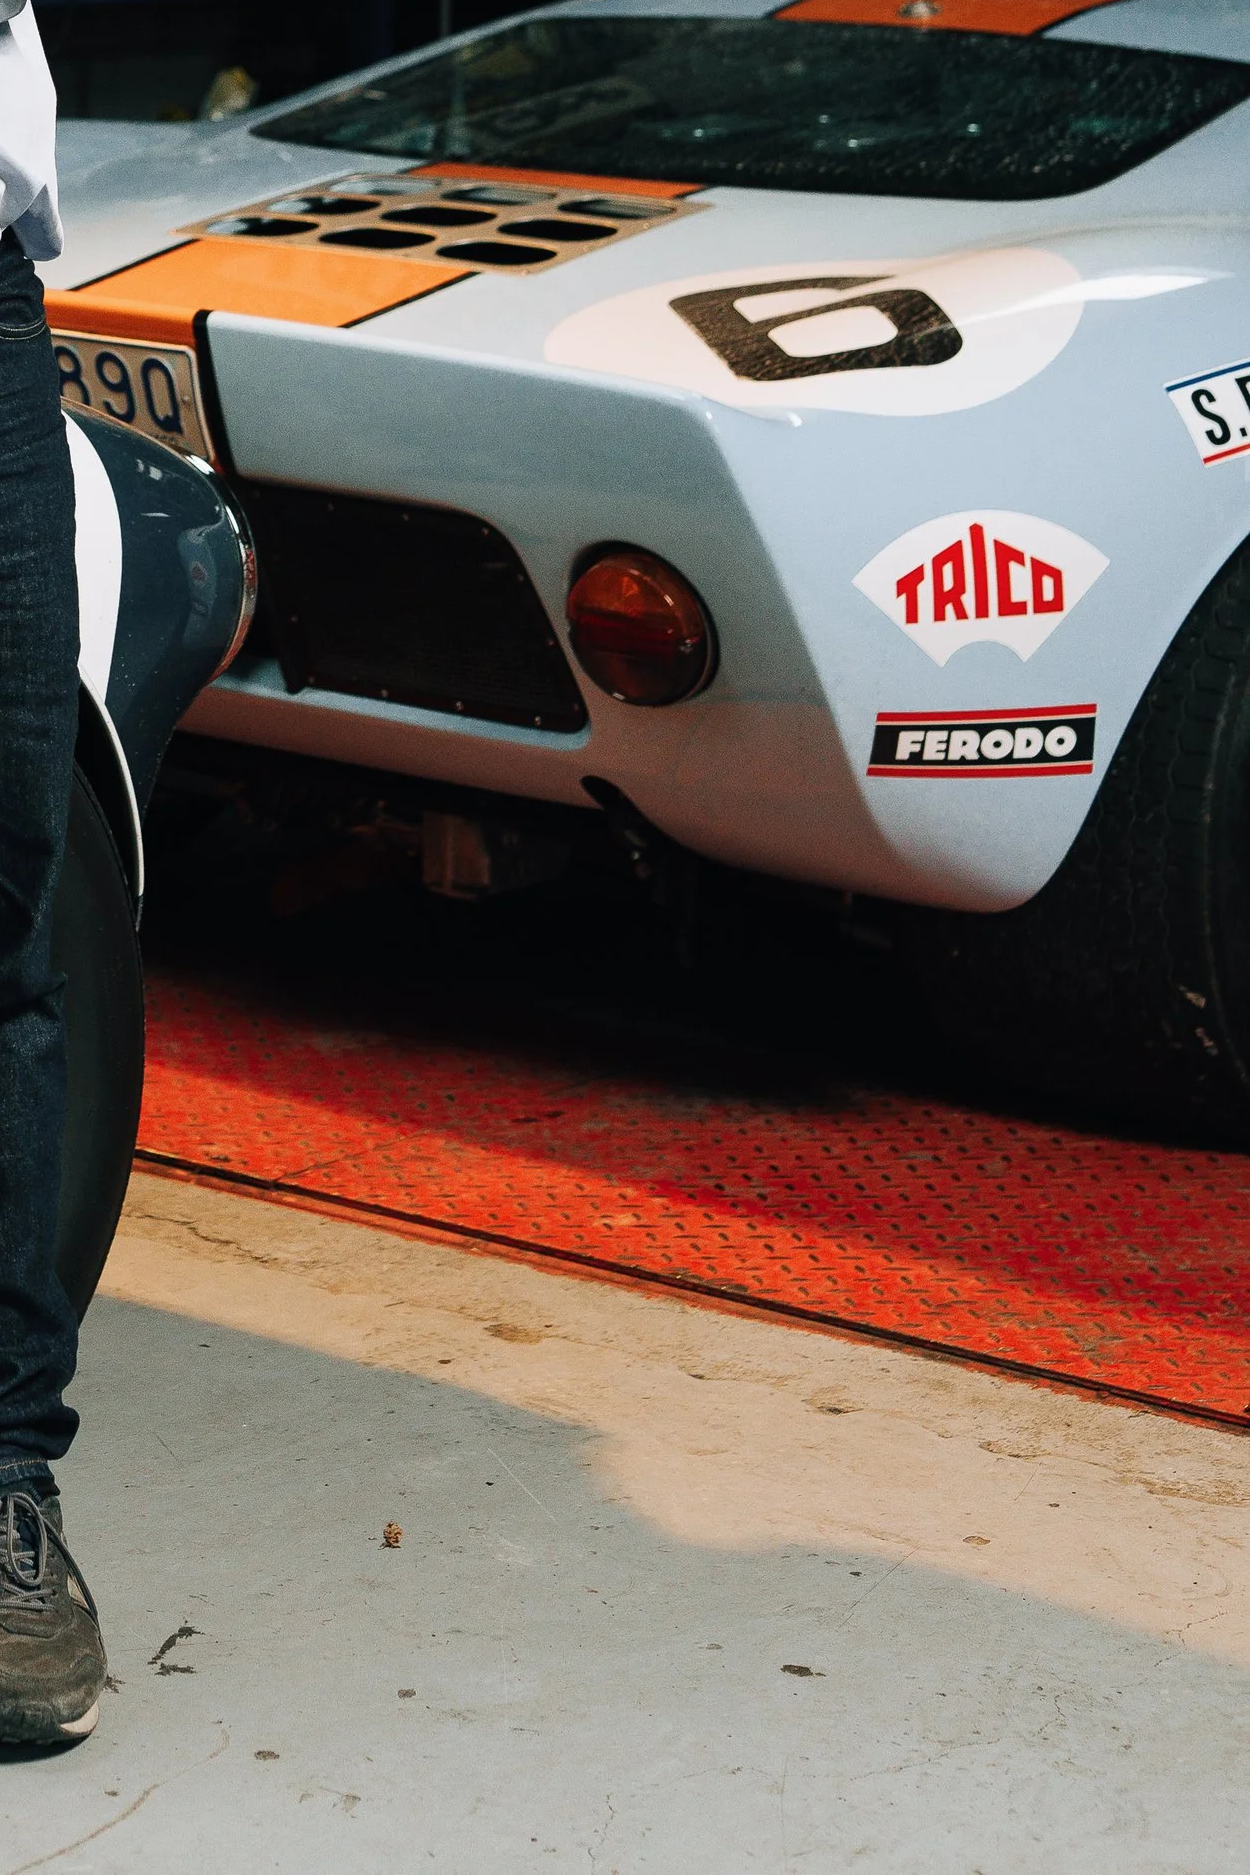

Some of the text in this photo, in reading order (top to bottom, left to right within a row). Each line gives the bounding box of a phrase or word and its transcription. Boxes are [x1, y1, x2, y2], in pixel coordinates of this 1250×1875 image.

[668, 275, 964, 382] 6
[895, 522, 1065, 625] TRICO
[894, 725, 1078, 762] FERODO
